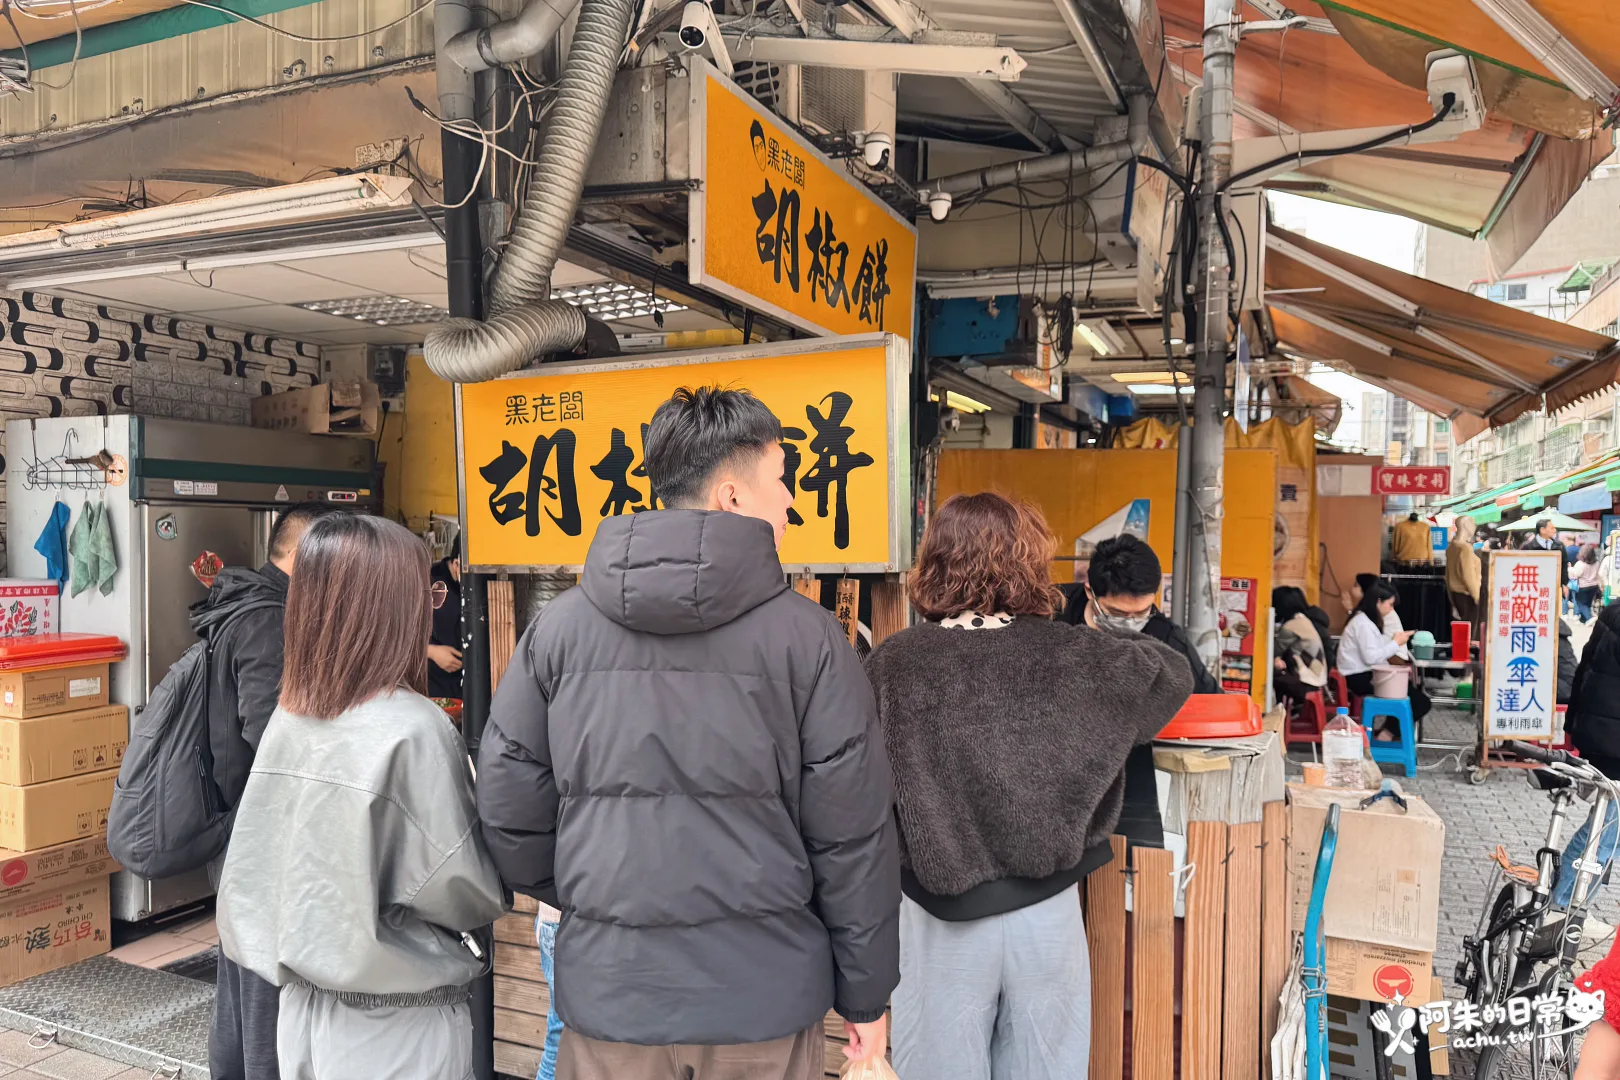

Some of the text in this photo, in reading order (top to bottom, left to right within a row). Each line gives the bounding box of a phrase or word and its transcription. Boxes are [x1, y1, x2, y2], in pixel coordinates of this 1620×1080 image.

[768, 137, 805, 189] 黑老闆
[752, 178, 890, 331] 胡椒餅
[505, 391, 584, 425] 黑老闆
